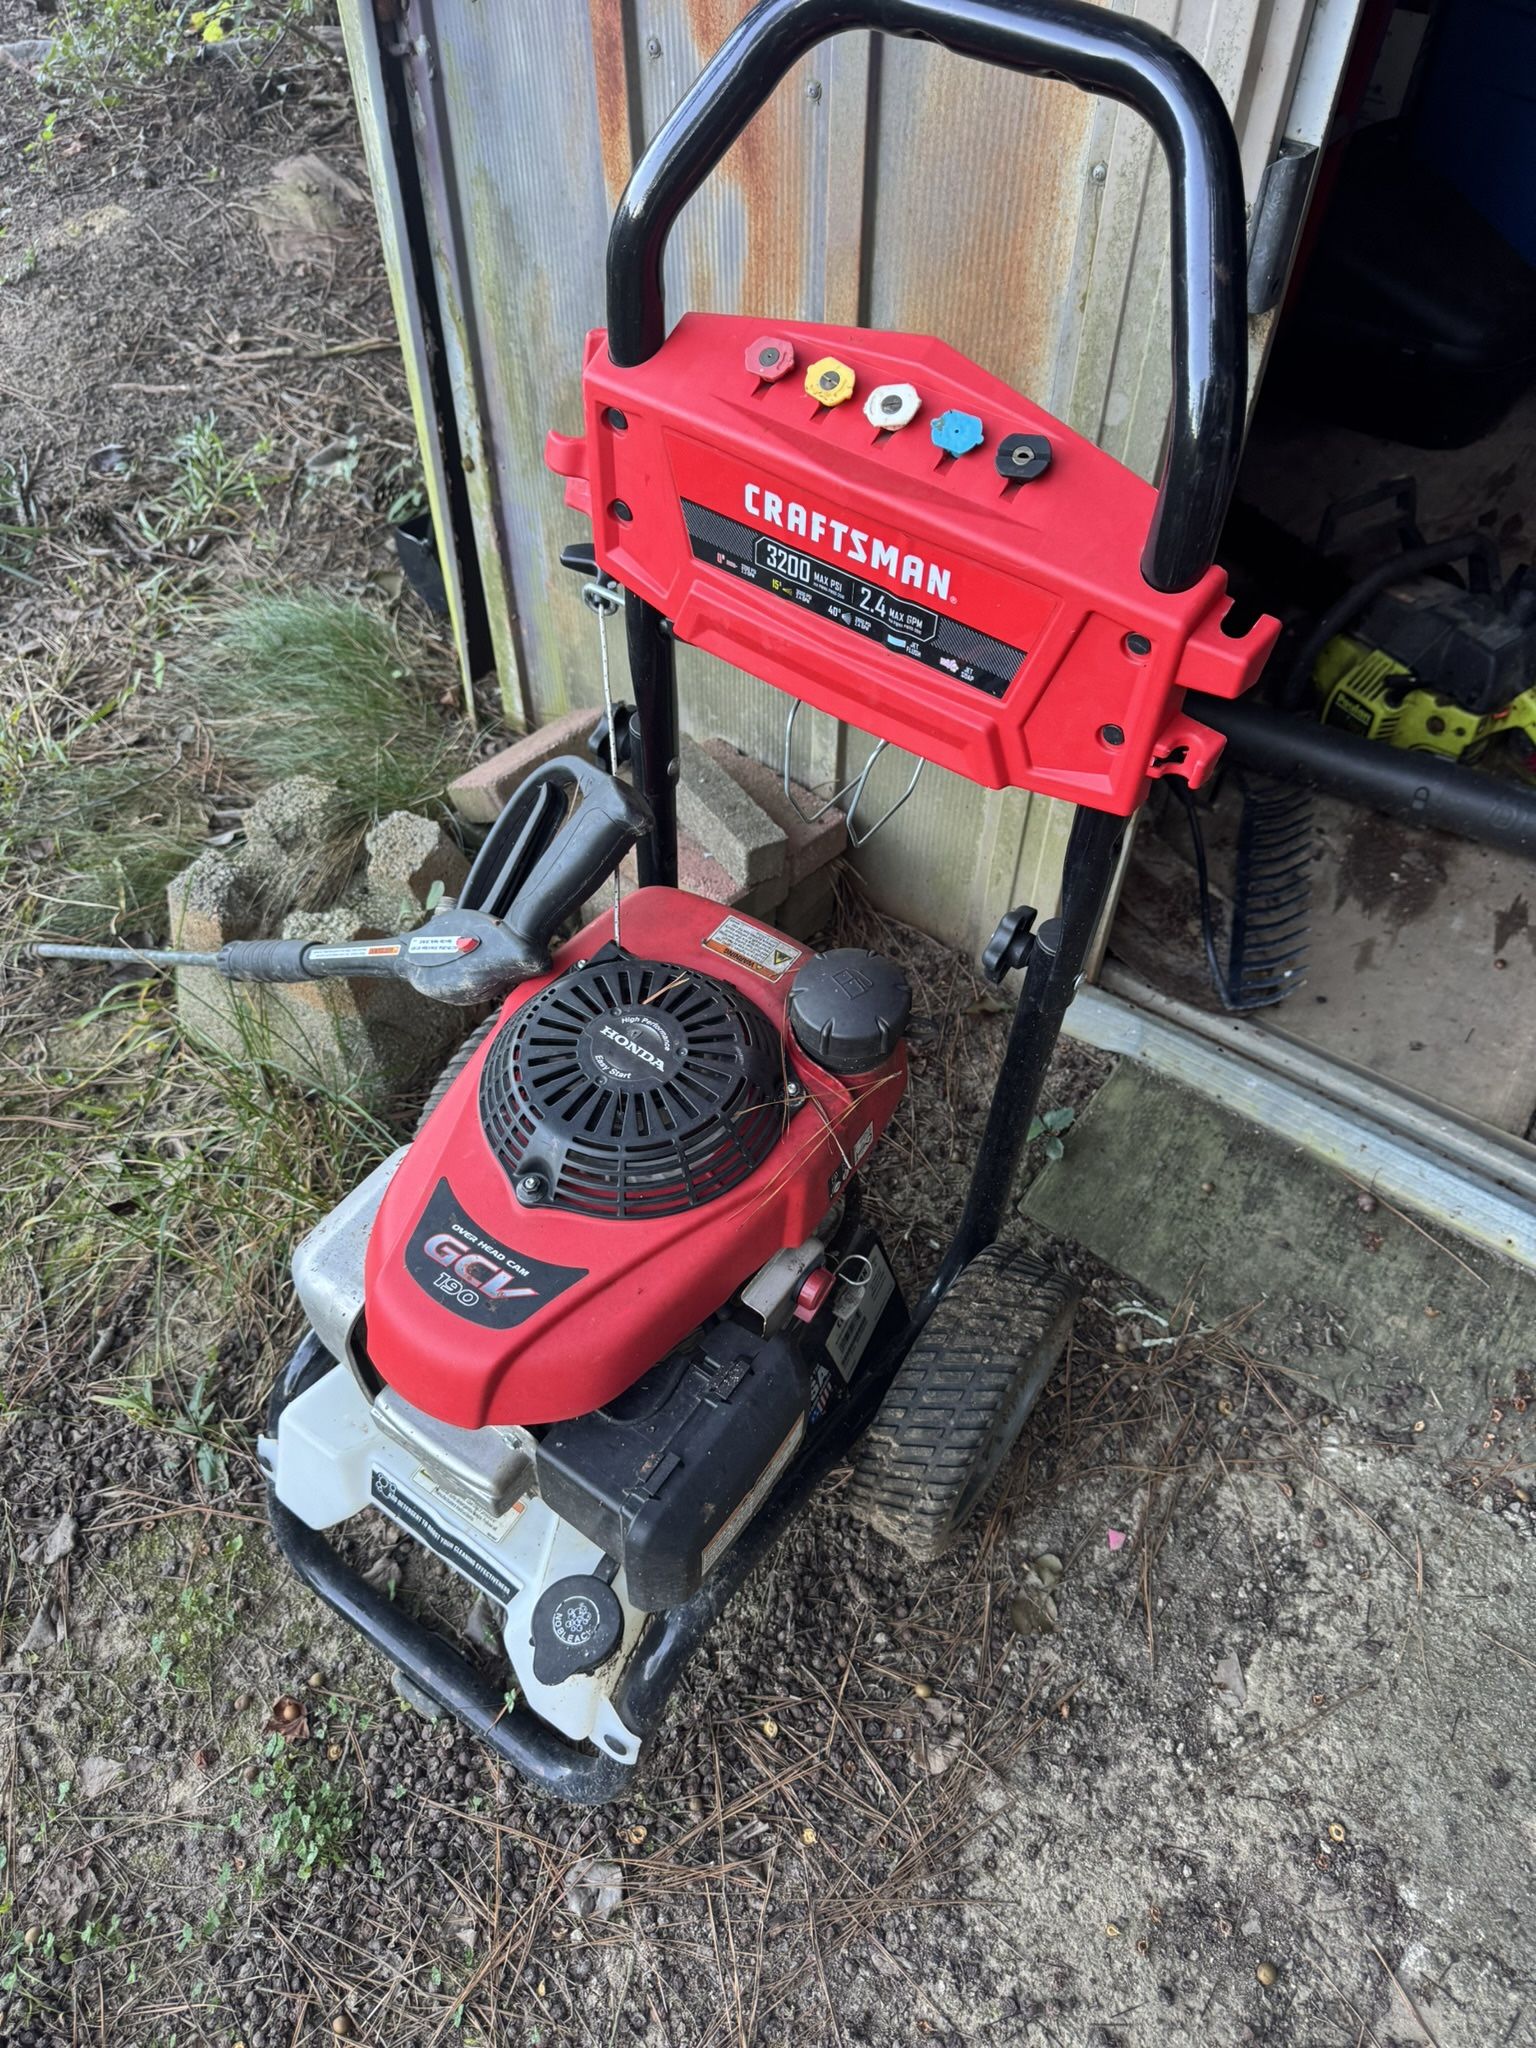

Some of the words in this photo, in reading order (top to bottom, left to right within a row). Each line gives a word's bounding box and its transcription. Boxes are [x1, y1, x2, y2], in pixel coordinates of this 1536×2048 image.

[744, 483, 951, 600] CRAFTSMAN
[766, 543, 811, 583] 3200
[813, 572, 829, 587] MAX
[830, 576, 843, 592] PSI
[859, 586, 887, 618] 2.4
[888, 607, 904, 622] MAX
[906, 614, 923, 630] GPM
[723, 947, 755, 968] WARNING
[600, 1025, 665, 1073] HONDA
[621, 1016, 640, 1024] High
[640, 1017, 671, 1052] Performance
[594, 1054, 610, 1071] Easy
[608, 1068, 632, 1079] Start
[423, 1233, 540, 1299] GCV
[451, 1223, 479, 1244] OVER
[477, 1240, 506, 1261] HEAD
[505, 1259, 531, 1277] CAM
[433, 1271, 480, 1307] 190
[397, 1497, 422, 1523] DETERGENT
[421, 1517, 428, 1529] TO
[440, 1535, 455, 1550] YOUR
[453, 1544, 476, 1567] CLEANING
[475, 1562, 511, 1595] EFFECTIVENESS
